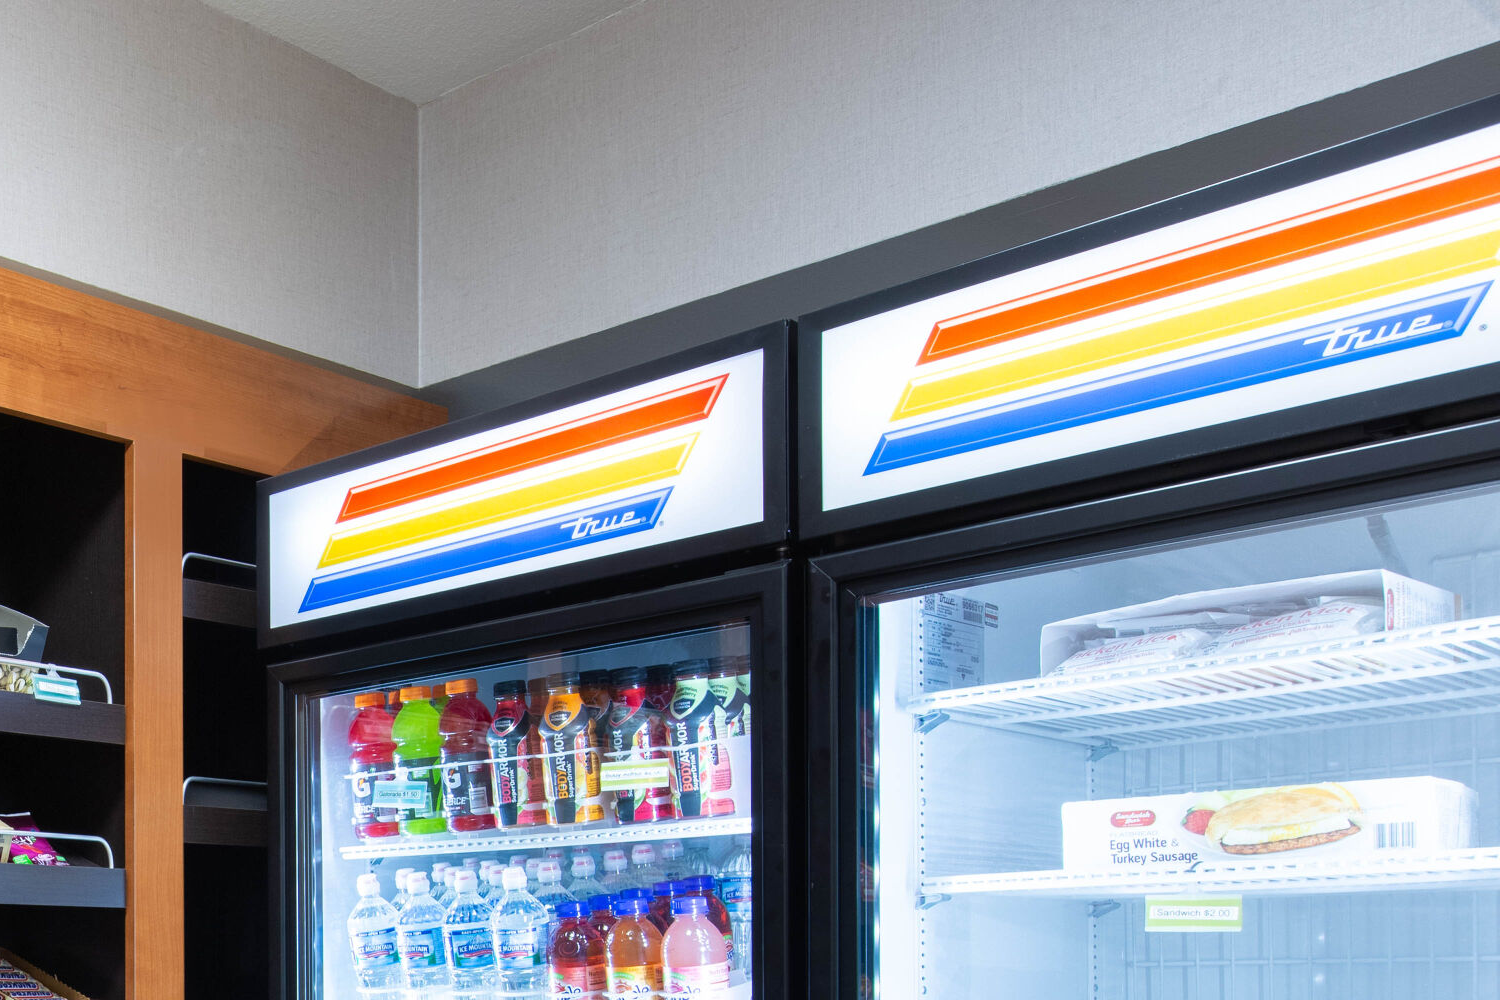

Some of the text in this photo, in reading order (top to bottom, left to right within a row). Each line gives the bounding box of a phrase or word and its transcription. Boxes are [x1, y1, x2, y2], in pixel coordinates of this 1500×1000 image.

[1110, 837, 1180, 853] Egg White &
[1111, 852, 1199, 866] Turkey Sausage
[1156, 908, 1230, 917] Sandwich $2.00
